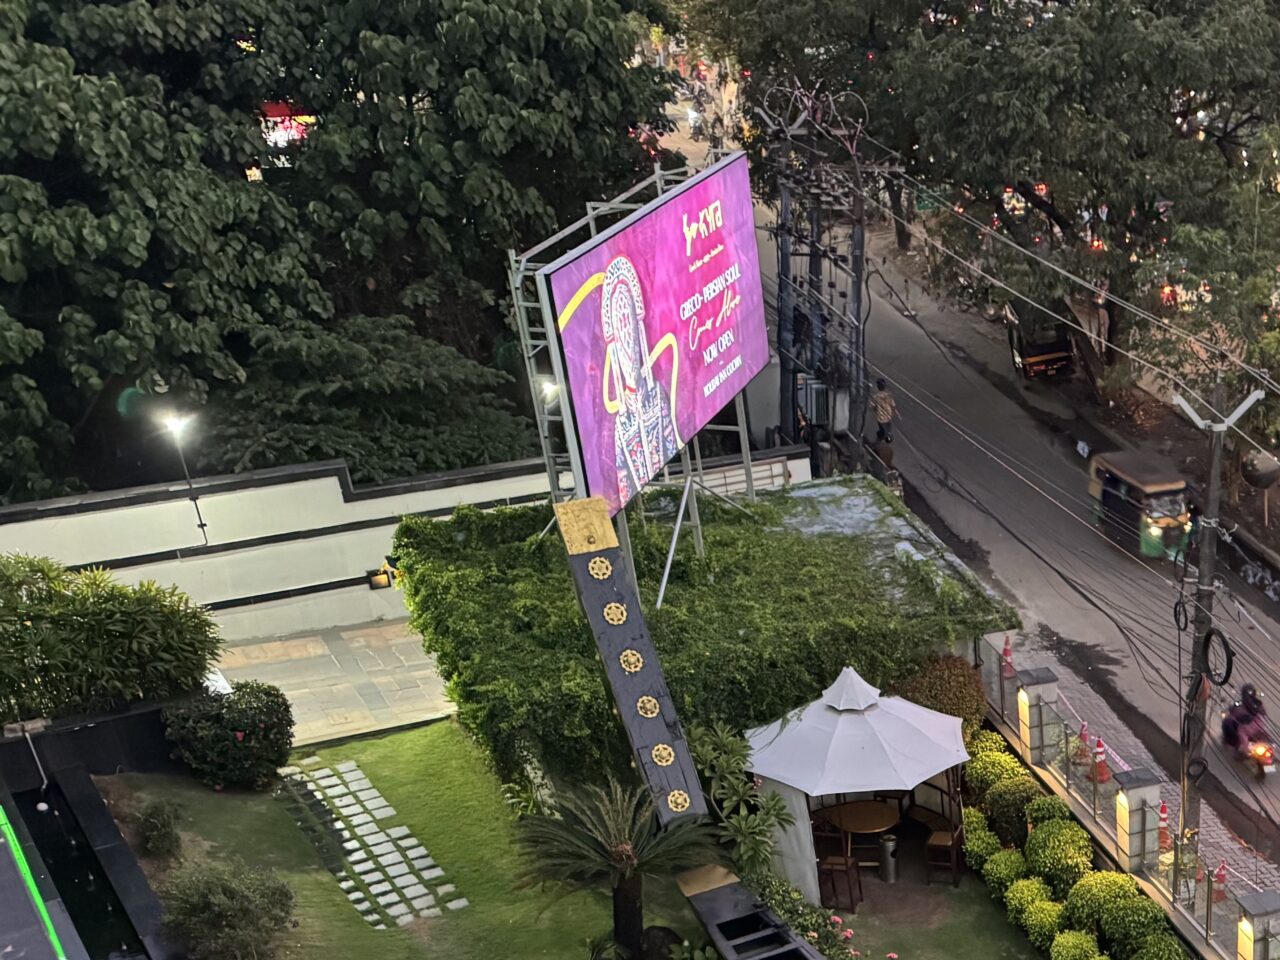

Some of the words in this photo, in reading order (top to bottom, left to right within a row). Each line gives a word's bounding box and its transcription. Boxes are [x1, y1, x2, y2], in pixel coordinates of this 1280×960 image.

[703, 273, 726, 303] PERSIAN
[725, 263, 741, 284] SOUL
[703, 344, 718, 367] NOW
[718, 329, 734, 351] OPEN
